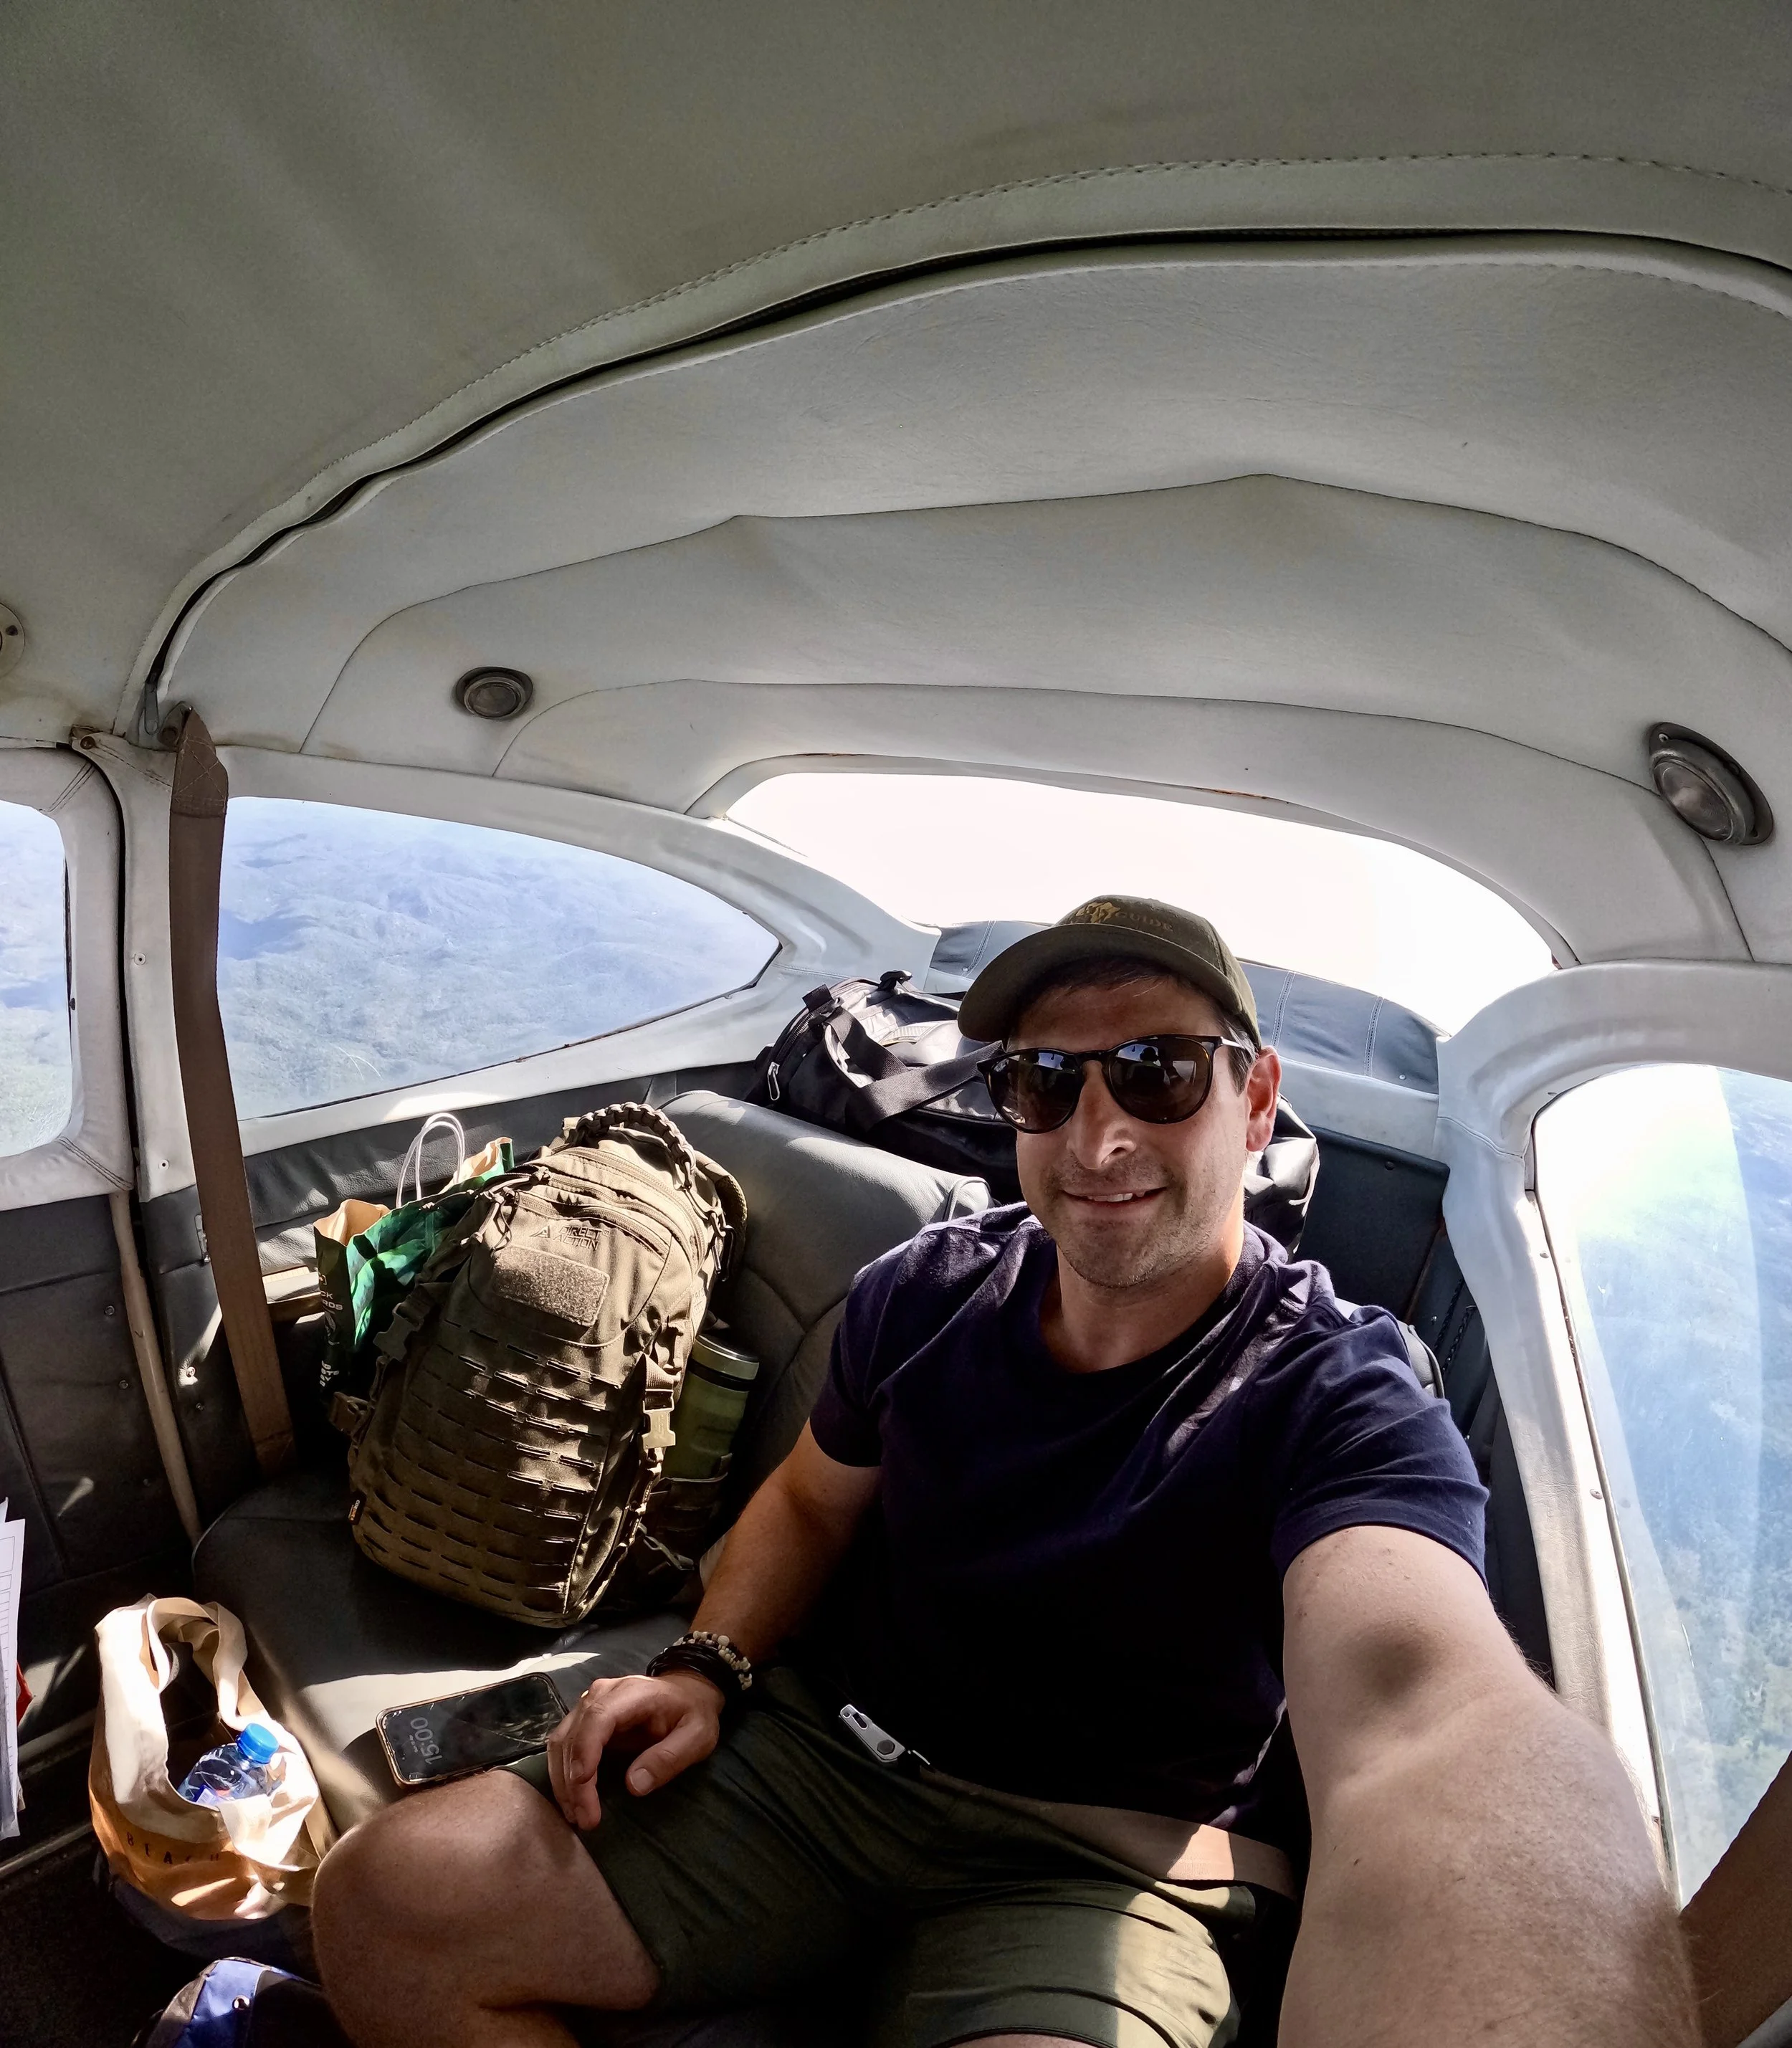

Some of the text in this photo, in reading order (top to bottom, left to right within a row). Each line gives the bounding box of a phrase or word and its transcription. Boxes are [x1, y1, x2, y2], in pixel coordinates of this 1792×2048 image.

[558, 1225, 604, 1240] DIRECT
[552, 1234, 601, 1252] ACTION
[410, 1717, 443, 1765] 15:00
